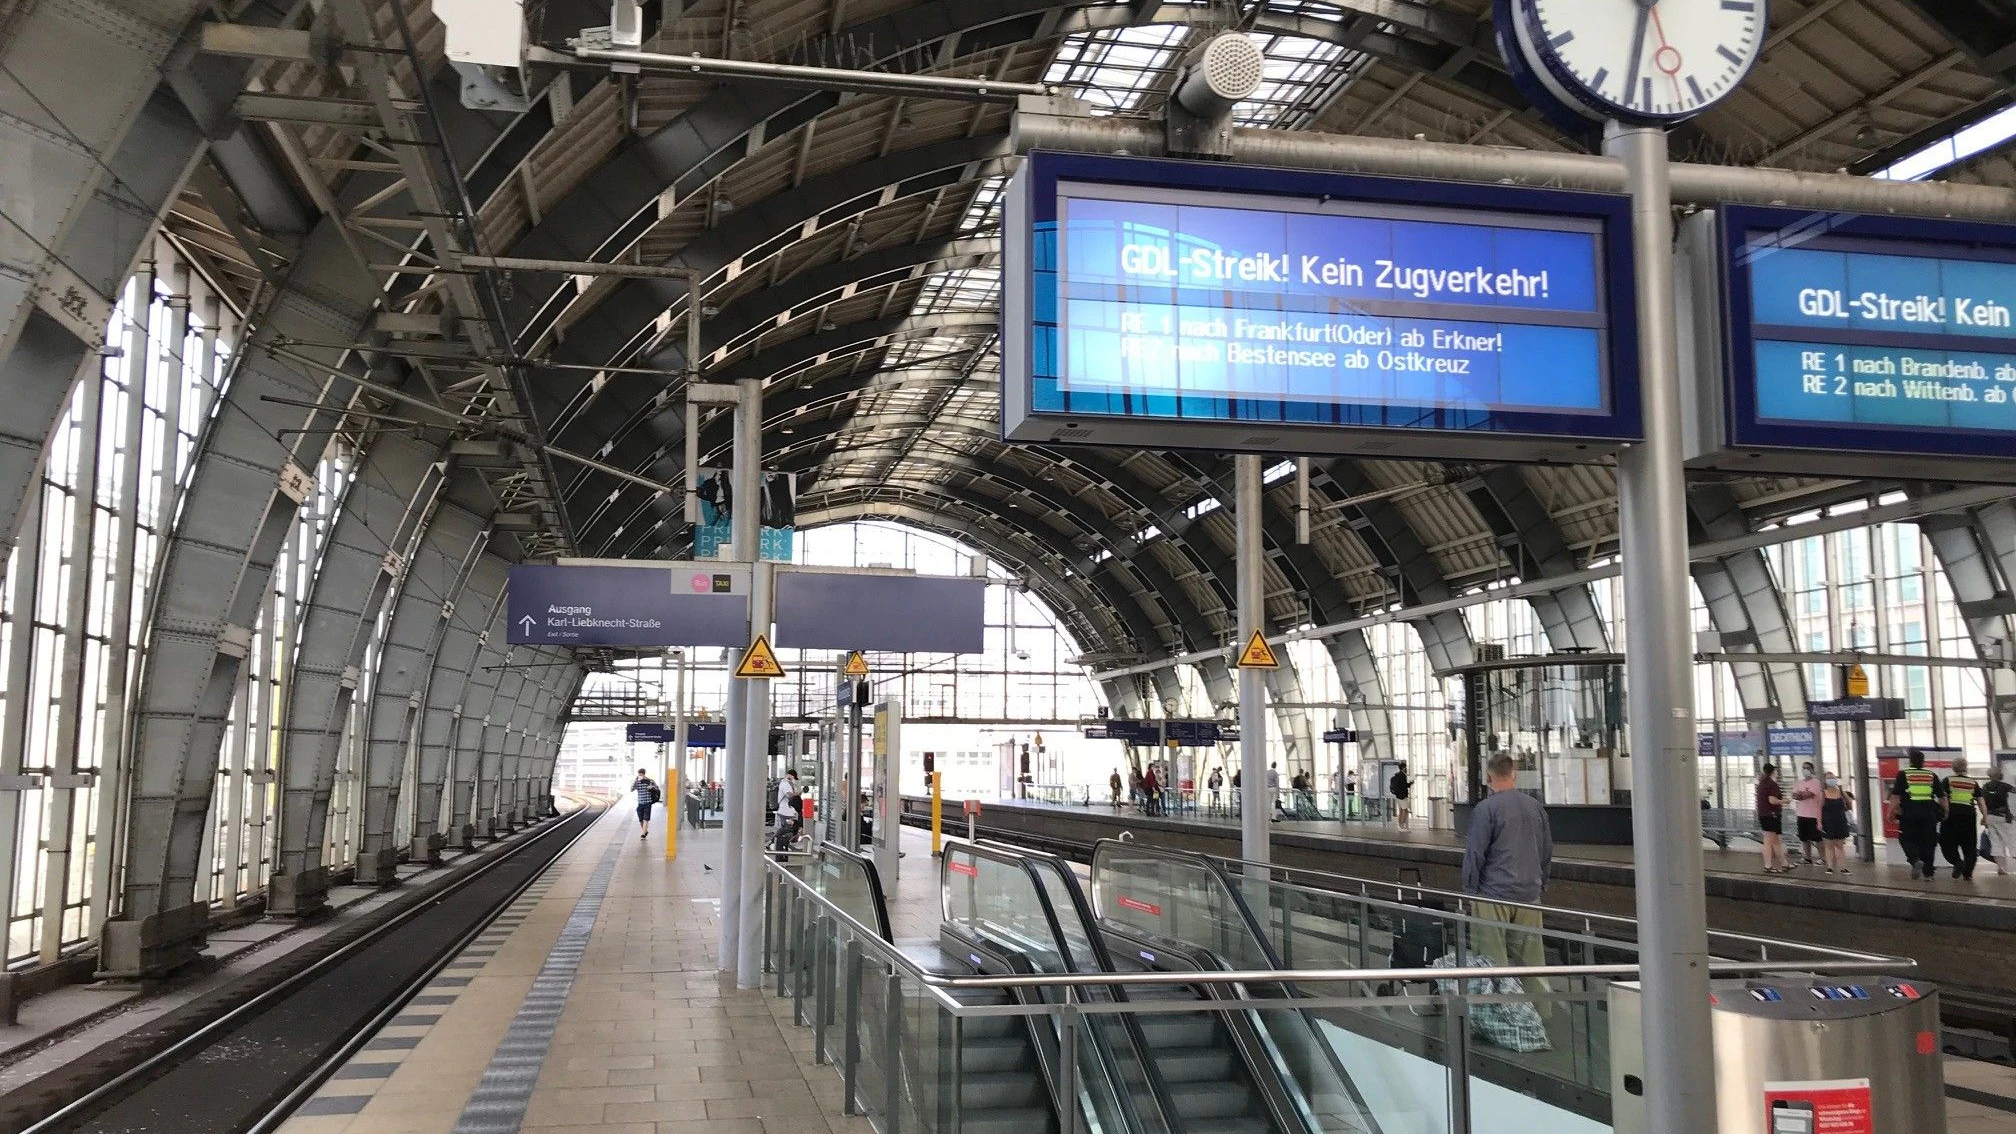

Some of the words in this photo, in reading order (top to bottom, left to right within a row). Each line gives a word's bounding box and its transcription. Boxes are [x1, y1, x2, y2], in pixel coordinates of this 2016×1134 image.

[1121, 243, 1290, 283] GDL-Streik!
[1301, 254, 1363, 288] Kein
[1374, 259, 1549, 299] Zugverkehr!
[1799, 288, 1946, 323] GDL-Streik!
[1954, 297, 2011, 327] Kein
[1180, 317, 1228, 338] nach
[1235, 318, 1392, 346] Frankfurt(Oder)
[1400, 328, 1425, 348] ab
[1432, 329, 1503, 352] Erkner!
[1227, 342, 1337, 368] Bestensee
[1344, 349, 1369, 369] ab
[1377, 350, 1470, 374] Ostkreuz
[1801, 351, 1827, 371] RE
[1834, 353, 1846, 372] 1
[1852, 356, 1896, 375] nach
[1901, 356, 1990, 380] Brandenb.
[1994, 363, 2016, 382] ab
[1802, 374, 1828, 394] RE
[1833, 376, 1848, 395] 2
[1854, 378, 1897, 398] nach
[1902, 379, 1979, 402] Wittenb.
[1983, 385, 2007, 404] ab
[547, 604, 592, 616] Ausgang
[547, 617, 661, 629] Karl-Liebknecht-Straße
